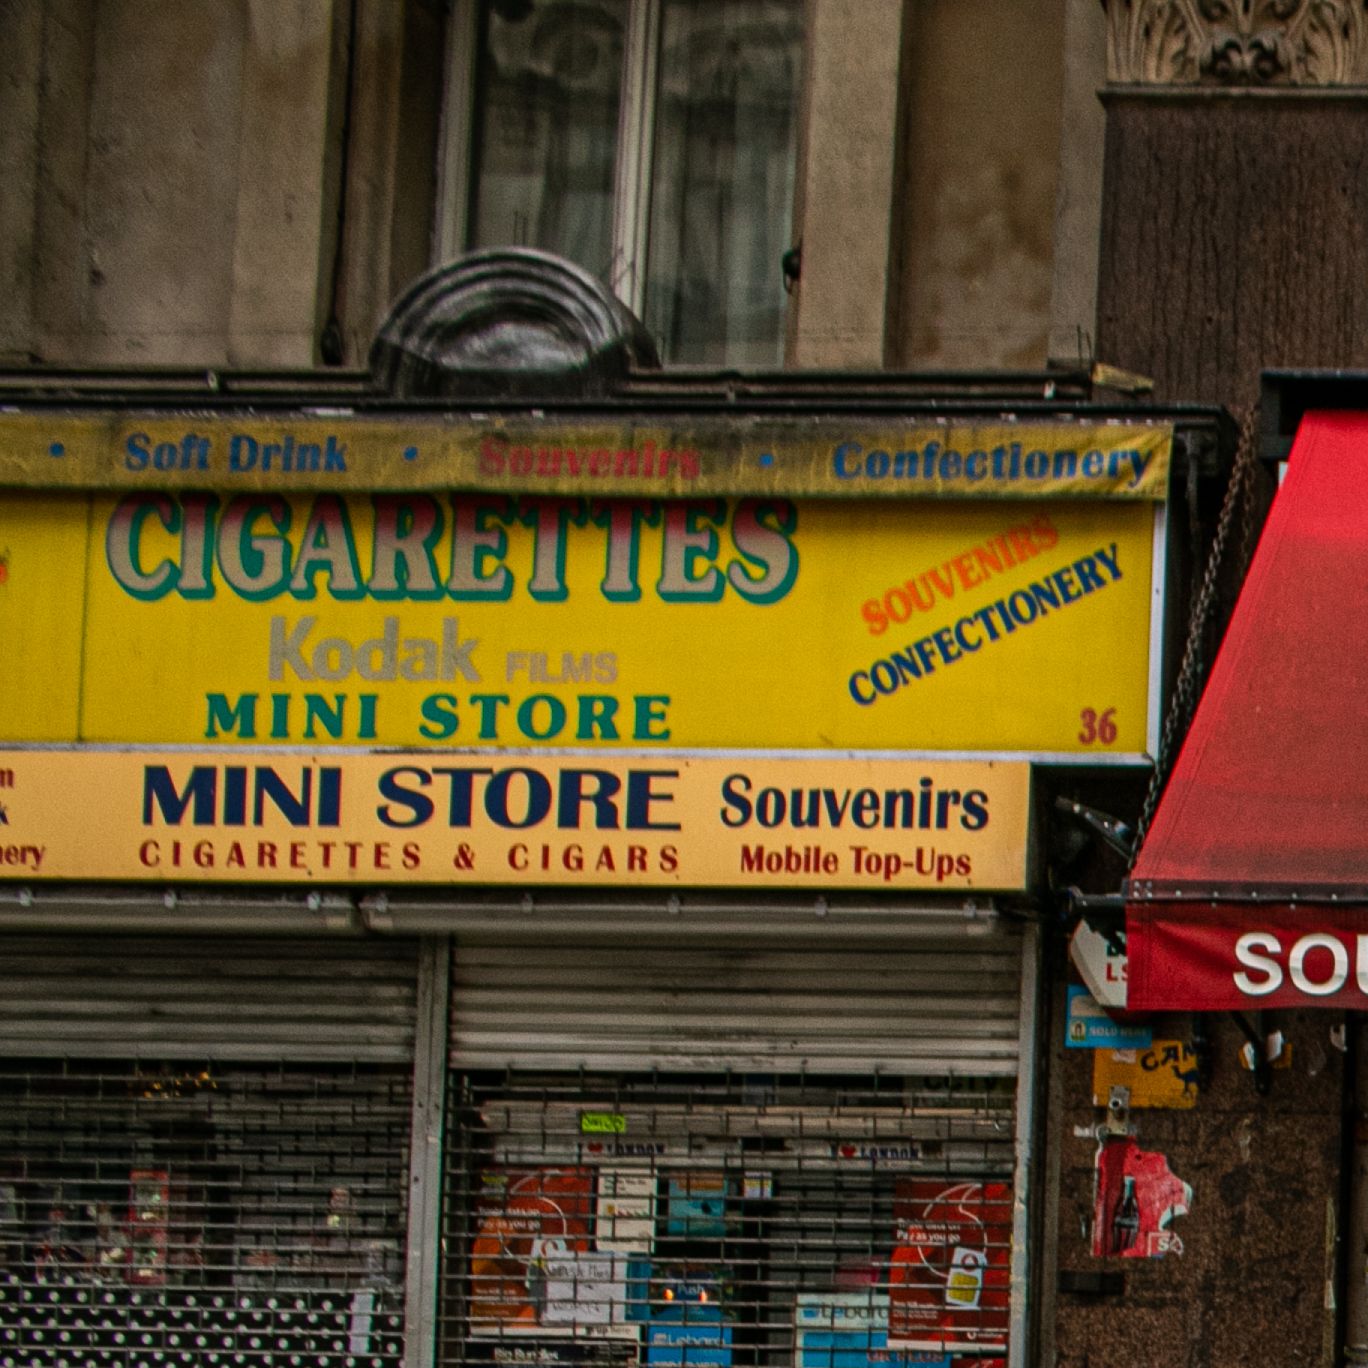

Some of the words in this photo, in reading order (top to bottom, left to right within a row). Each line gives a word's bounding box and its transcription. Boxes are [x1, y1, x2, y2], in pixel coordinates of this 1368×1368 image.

[125, 431, 212, 473] Soft
[228, 434, 349, 474] Drink
[477, 436, 700, 480] Souvenirs
[832, 441, 1154, 488] Confectionery
[106, 492, 800, 606] CIGARETTES
[860, 512, 1062, 637] SOUVENIRS
[268, 614, 483, 684] Kodak
[504, 651, 619, 685] FILMS
[848, 542, 1126, 707] CONFECTIONERY
[203, 692, 380, 741] MINI
[417, 692, 673, 742] STORE
[1077, 706, 1119, 746] 36
[140, 764, 343, 828] MINI
[375, 765, 683, 832] STORE
[719, 772, 990, 832] Souvenirs
[138, 840, 422, 871] CIGARETTES
[453, 842, 477, 871] &
[507, 842, 680, 873] CIGARS
[740, 844, 840, 877] Mobile
[849, 844, 973, 882] Top-Ups
